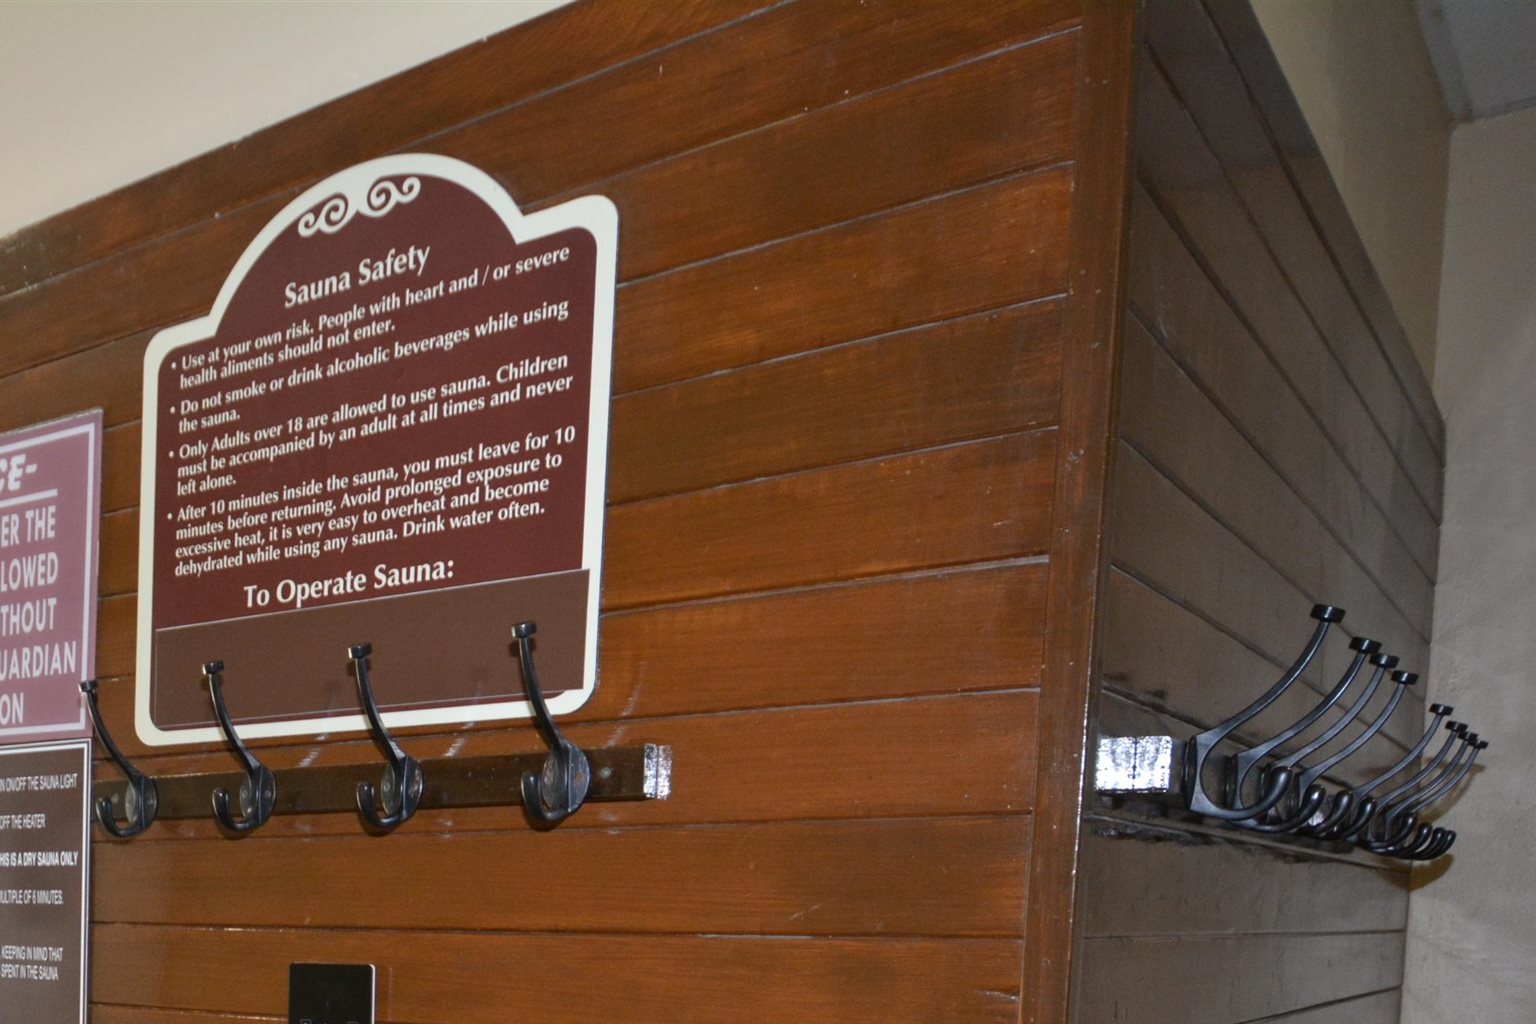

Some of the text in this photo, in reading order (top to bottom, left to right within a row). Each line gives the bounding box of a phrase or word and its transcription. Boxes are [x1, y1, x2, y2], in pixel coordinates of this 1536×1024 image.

[284, 245, 431, 309] Sauna Safety
[181, 247, 570, 371] Use at your own risk. People with heart and / or severe
[179, 319, 396, 390] health aliments should not enter.
[180, 300, 569, 416] Do not smoke or drink alcoholic beverages while using
[177, 375, 574, 478] must be accompanied by an adult at all times and never
[178, 354, 568, 460] Only Adults over 18 are allowed to use sauna. Children
[178, 409, 241, 434] the sauna.
[175, 452, 563, 541] minutes before returning. Avoid prolonged exposure to
[176, 425, 576, 522] After 10 minutes inside the sauna, you must leave for 10
[176, 474, 237, 497] left alone.
[25, 505, 56, 541] THE
[174, 500, 545, 577] dehydrated while using any sauna. Drink water often.
[175, 478, 550, 559] excessive heat, it is very easy to overheat and become
[243, 559, 454, 608] To Operate Sauna:
[27, 776, 39, 791] THE
[39, 775, 58, 790] SAUNA
[60, 774, 77, 789] LIGHT
[10, 814, 21, 829] THE
[22, 813, 45, 829] HEATER
[10, 852, 17, 866] IS
[17, 852, 22, 866] A
[22, 852, 36, 866] DRY
[37, 851, 59, 866] SAUNA
[60, 851, 78, 866] ONLY
[23, 889, 31, 903] OF
[26, 964, 37, 979] THE
[38, 965, 59, 981] SAUNA
[33, 946, 48, 961] MIND
[48, 947, 63, 961] THAT
